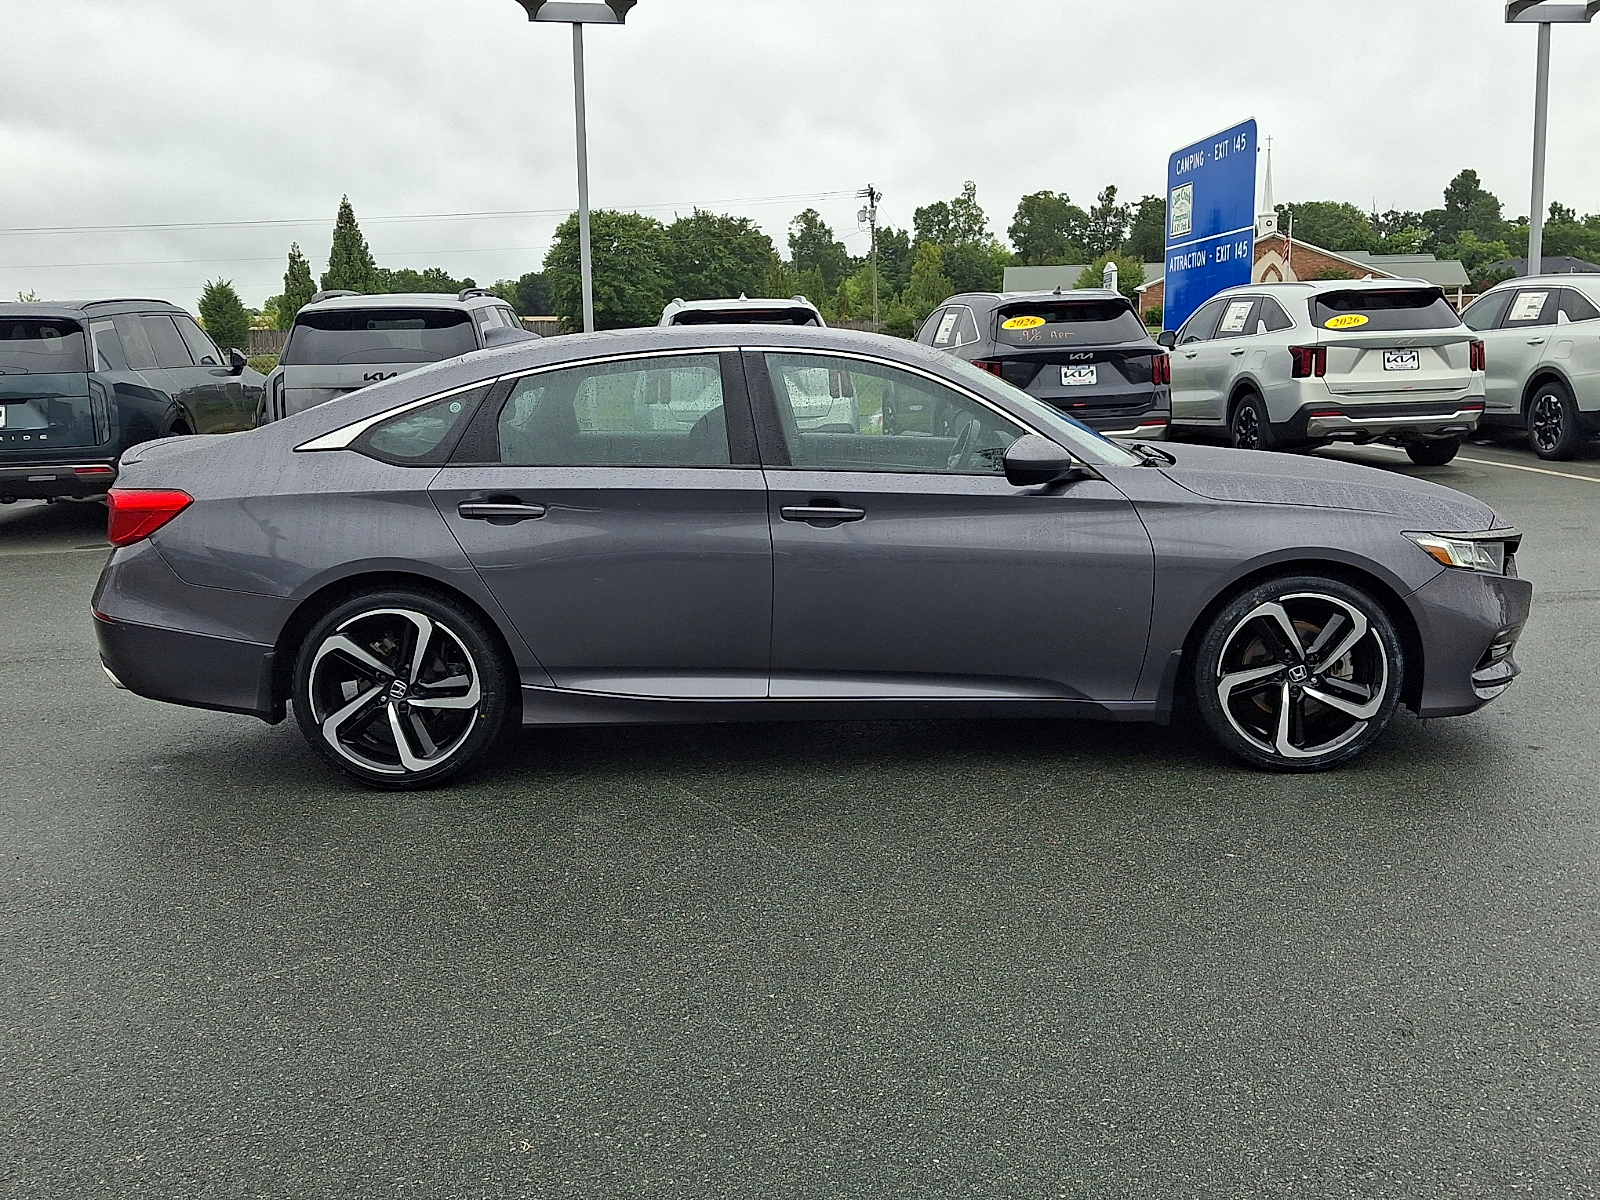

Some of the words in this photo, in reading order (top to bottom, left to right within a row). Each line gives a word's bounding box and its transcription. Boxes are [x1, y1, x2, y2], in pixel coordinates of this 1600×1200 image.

[1176, 150, 1204, 176] CAMPING
[1214, 139, 1229, 161] EXIT
[1233, 132, 1246, 154] 145
[1169, 249, 1206, 272] ATTRACTION
[1215, 243, 1231, 263] EXIT
[1234, 240, 1248, 260] 145
[1008, 318, 1037, 328] 2026
[1332, 316, 1361, 327] 2026
[1069, 352, 1094, 360] KIA
[1386, 354, 1416, 363] KIA
[1063, 369, 1094, 379] KIA
